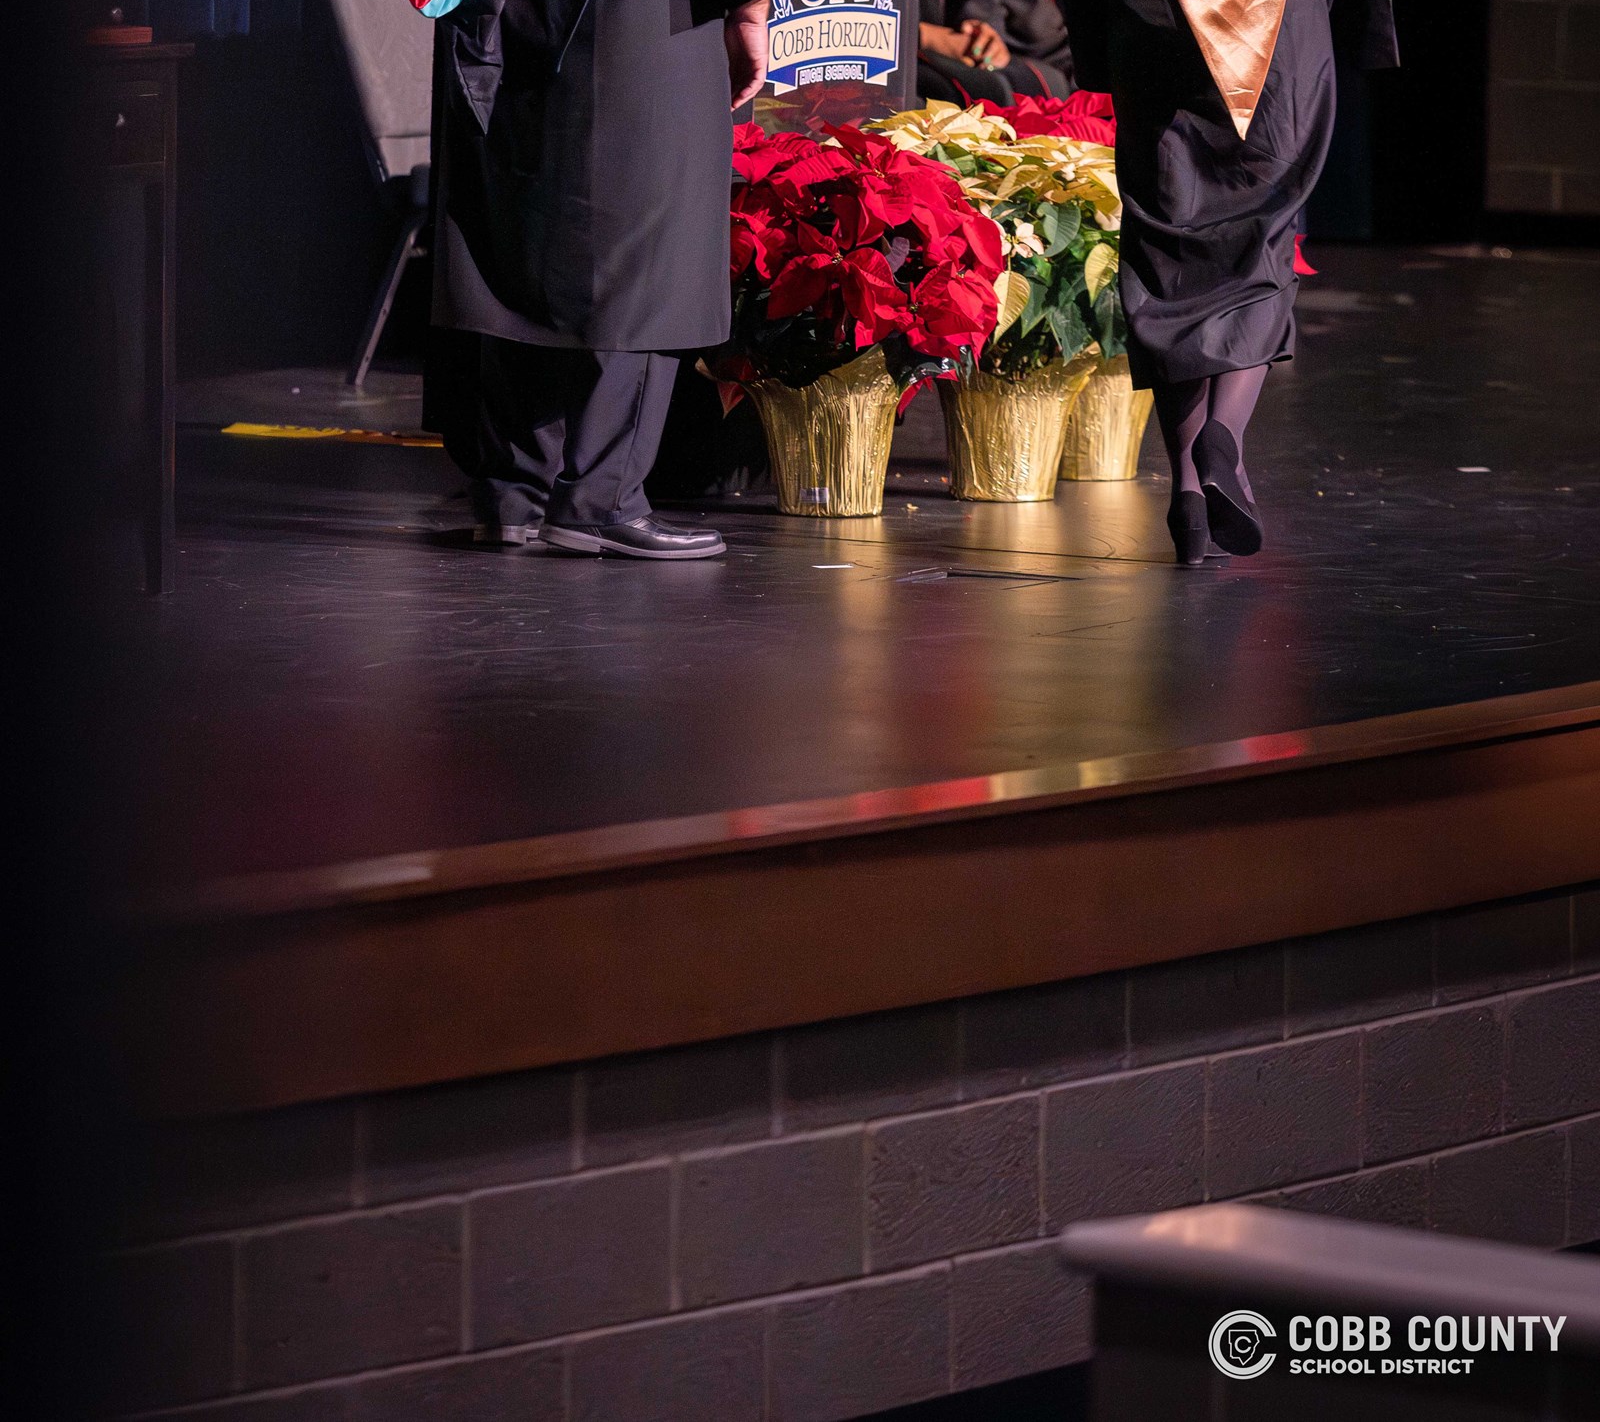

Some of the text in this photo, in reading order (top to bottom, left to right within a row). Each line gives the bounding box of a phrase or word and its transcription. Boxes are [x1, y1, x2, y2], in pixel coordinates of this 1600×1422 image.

[772, 20, 892, 60] COBB HORIZON
[799, 64, 864, 86] HIGH SCHOOL
